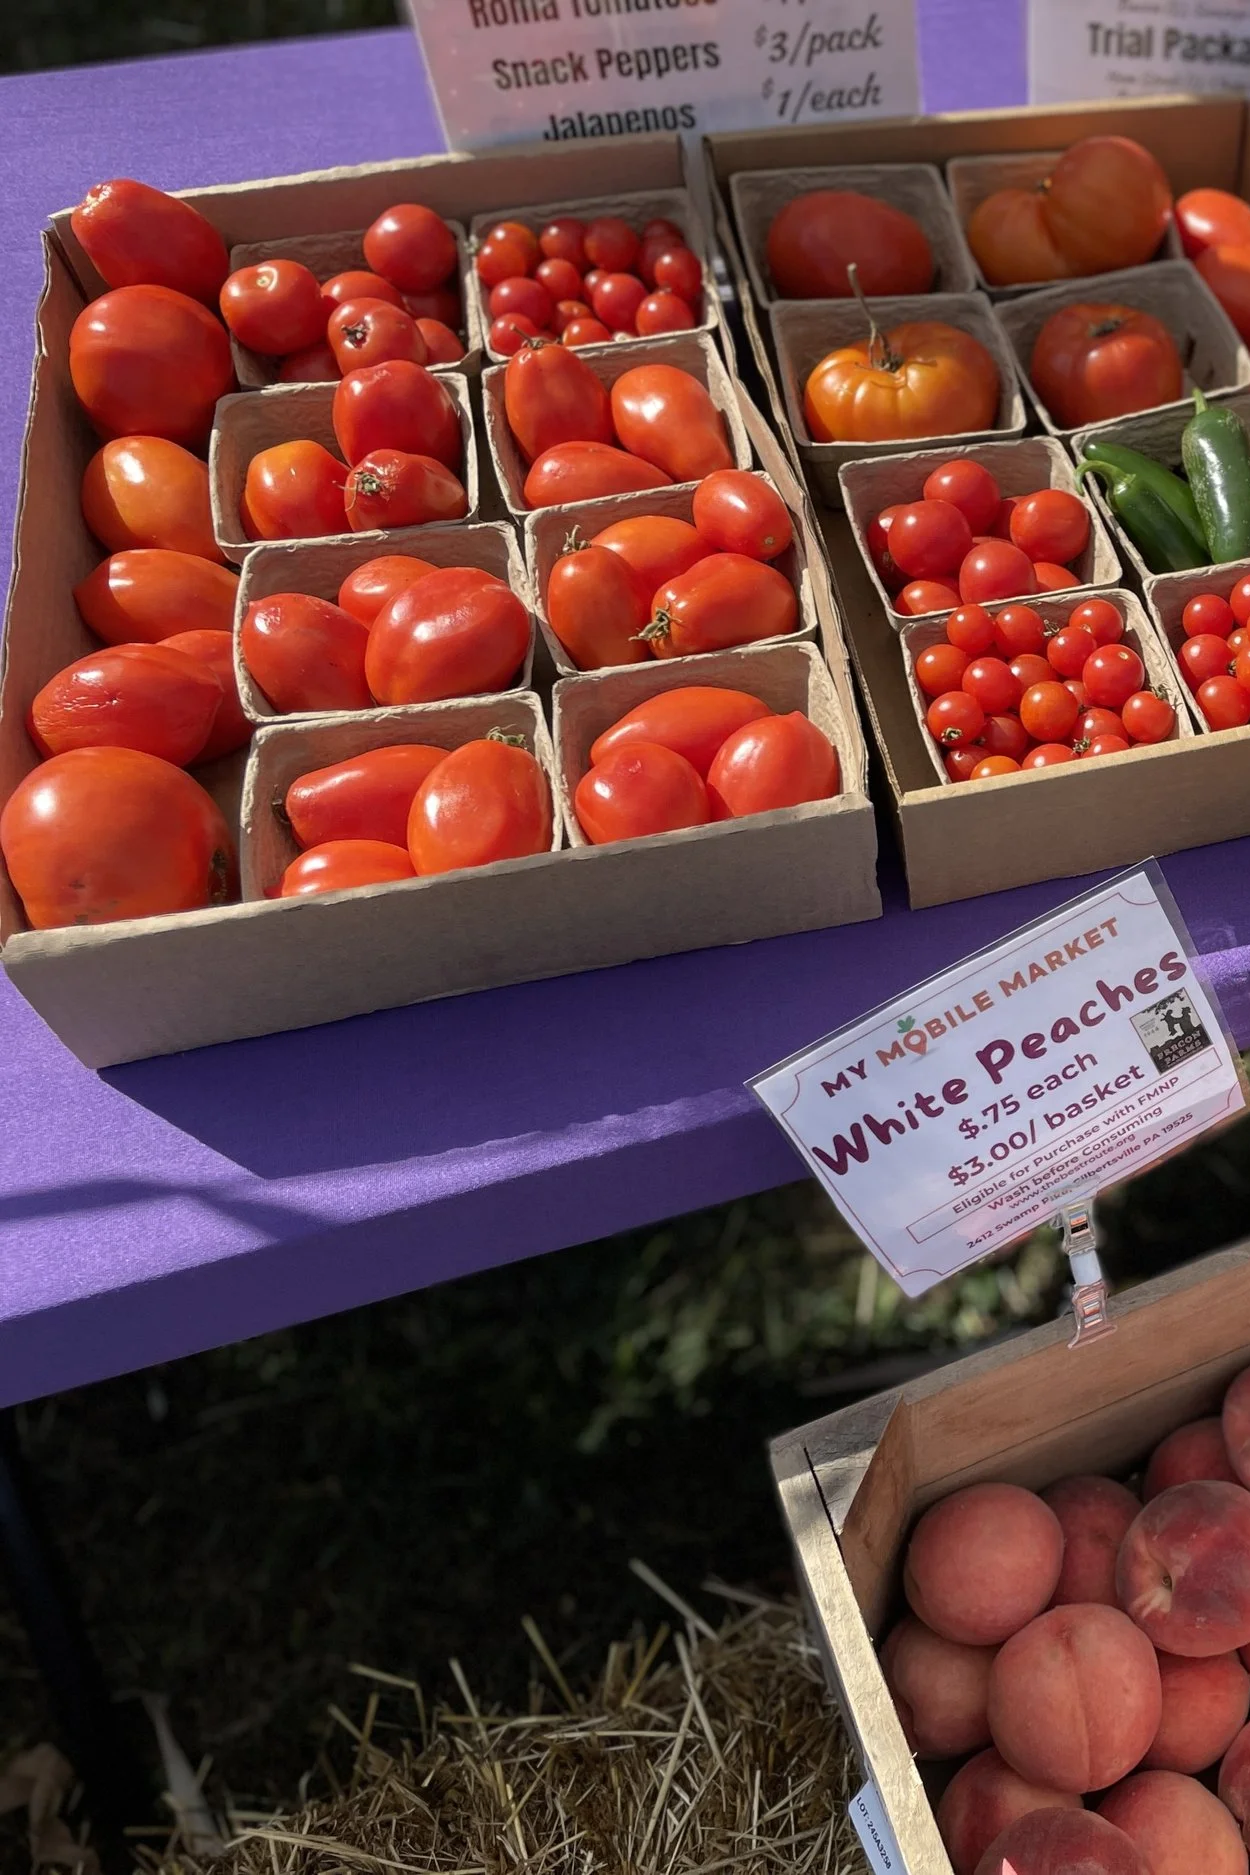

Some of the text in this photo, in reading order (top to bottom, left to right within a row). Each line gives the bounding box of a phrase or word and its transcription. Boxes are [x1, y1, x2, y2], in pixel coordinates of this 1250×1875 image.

[469, 0, 560, 28] Roma
[492, 13, 883, 90] Snack Peppers $3/pack
[1087, 22, 1154, 61] Trial
[543, 71, 882, 141] Jalapenos $1/each
[820, 917, 1120, 1097] MY MOBILE MARKET
[811, 951, 1188, 1176] White Peaches
[958, 1051, 1099, 1141] $.75 each
[947, 1064, 1145, 1187] $3.00/ basket
[952, 1076, 1180, 1214] Eligible for Purchase with FMNP
[987, 1105, 1164, 1211] Wash before Consuming
[1008, 1132, 1137, 1210] www.thebestroute.org
[966, 1229, 994, 1249] 2412
[994, 1203, 1040, 1232] Swamp
[1143, 1132, 1161, 1146] PA
[1162, 1112, 1194, 1134] 19525
